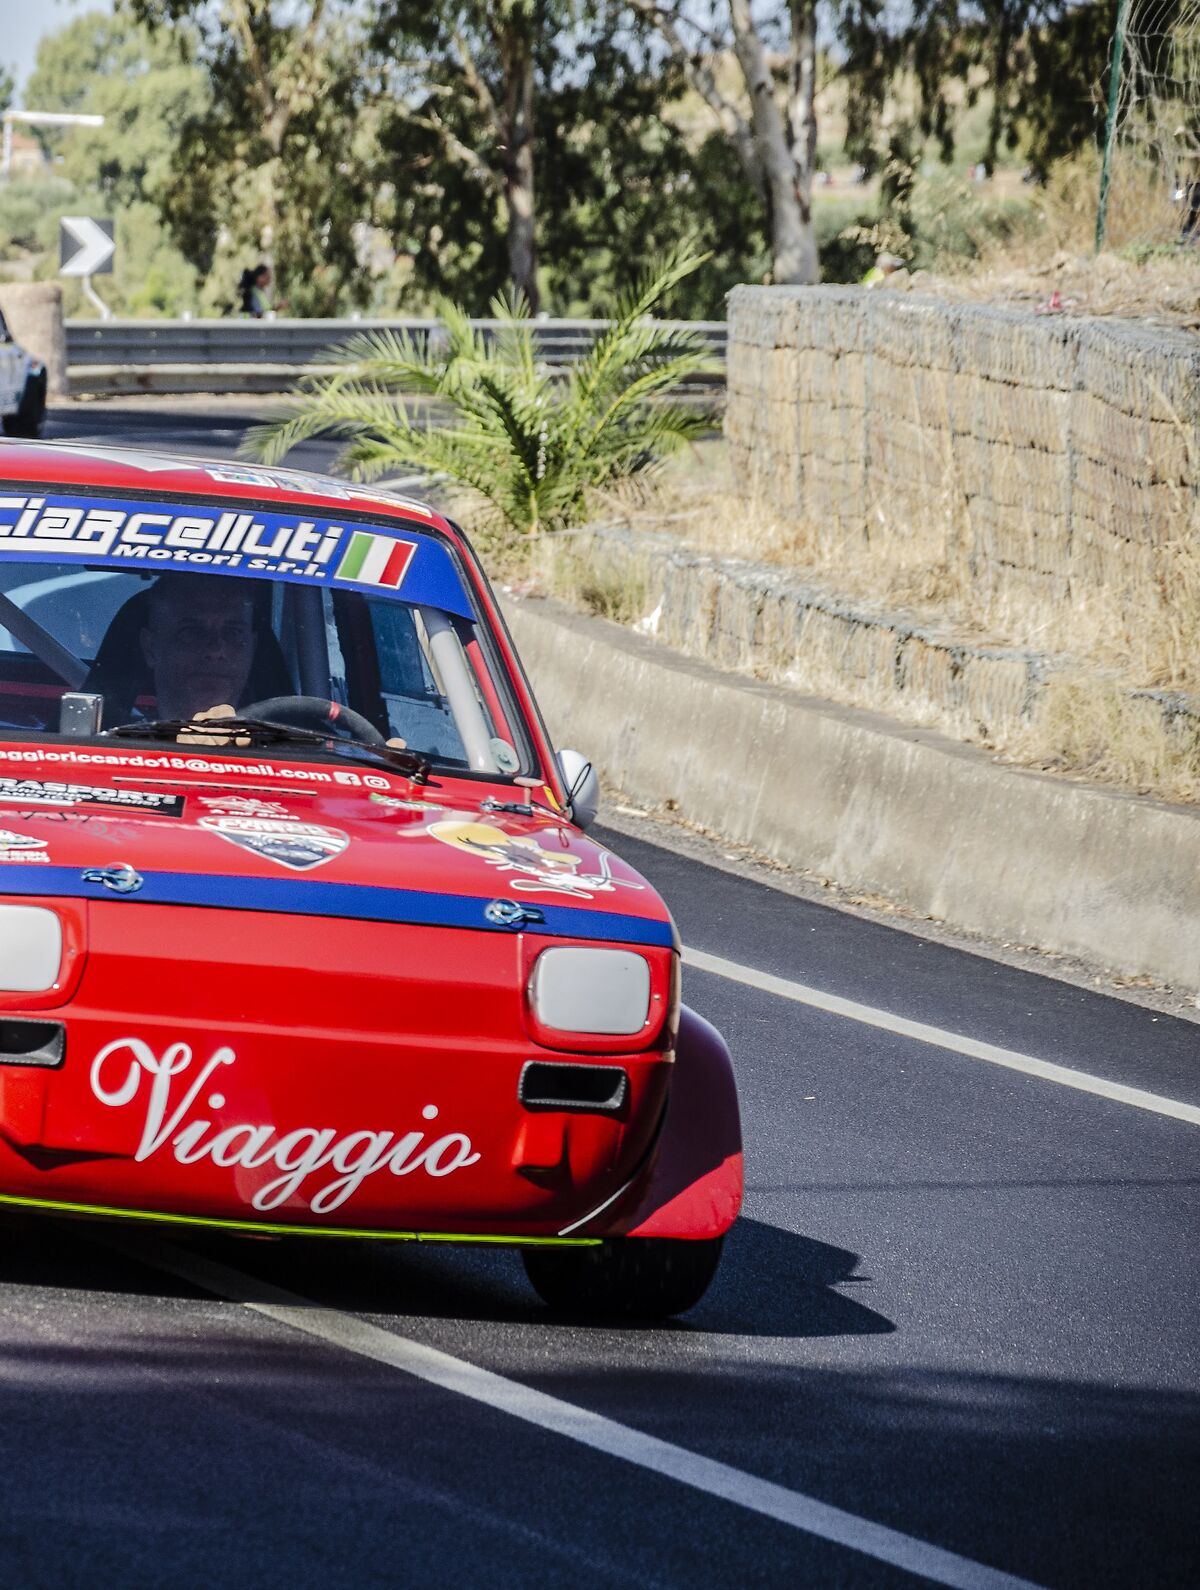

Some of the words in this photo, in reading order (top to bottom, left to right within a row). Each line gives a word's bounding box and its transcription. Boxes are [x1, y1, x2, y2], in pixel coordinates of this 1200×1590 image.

[111, 543, 242, 569] Motori
[247, 556, 327, 578] s.r.l.
[90, 1037, 482, 1214] Viaggio
